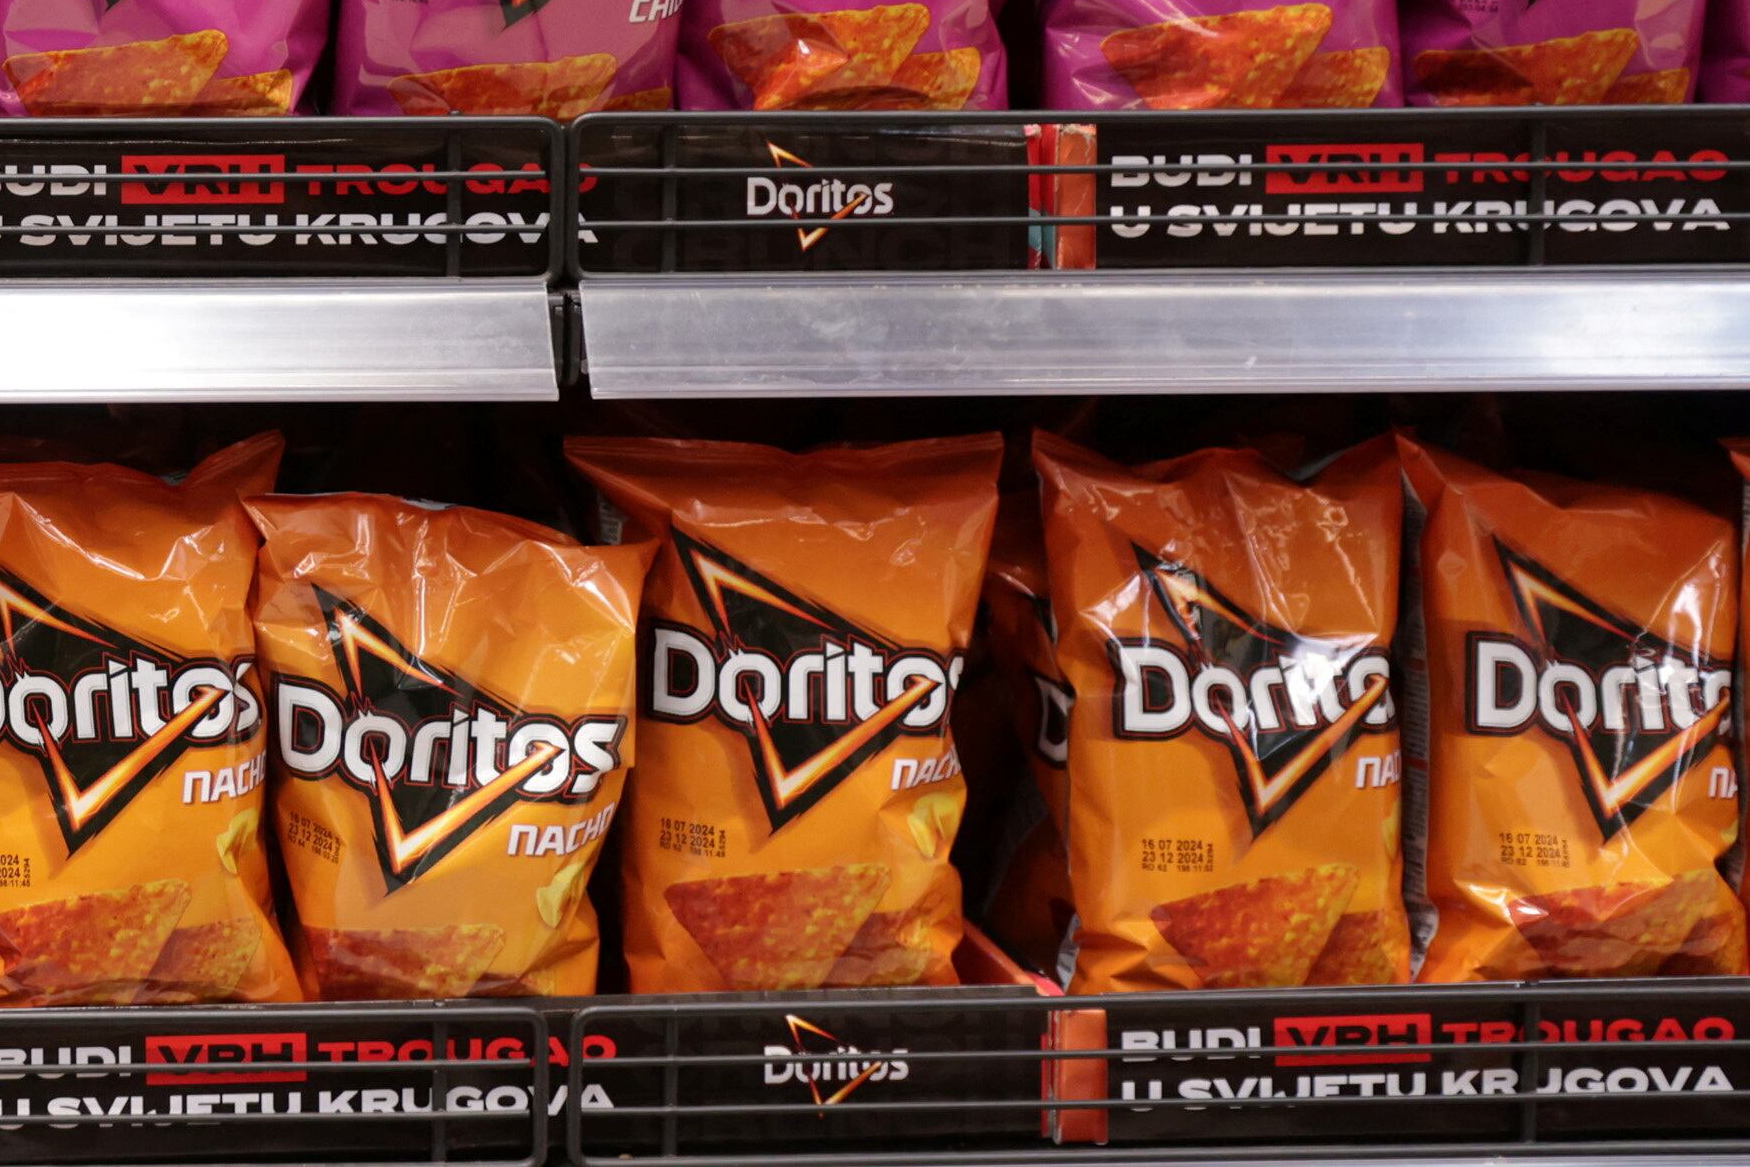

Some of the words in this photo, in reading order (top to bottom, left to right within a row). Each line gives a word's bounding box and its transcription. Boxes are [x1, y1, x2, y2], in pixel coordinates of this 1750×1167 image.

[132, 162, 274, 195] VRH
[1111, 154, 1252, 187] BUDI
[1277, 150, 1413, 185] VRH
[747, 177, 894, 215] Doritos
[19, 214, 280, 246] SVIJETU
[1111, 205, 1151, 238] U
[1166, 202, 1417, 236] SVIJETU
[1433, 198, 1731, 232] KRUGOVA
[1120, 644, 1395, 733] Dorito
[1477, 640, 1731, 733] Dorit
[279, 681, 622, 794] Doritos
[891, 742, 961, 790] NACH
[508, 806, 614, 857] NACHO
[1177, 839, 1203, 850] 2024
[1142, 850, 1155, 862] 23
[1160, 852, 1173, 863] 12
[1177, 852, 1203, 864] 2024
[158, 1043, 295, 1075] VRH
[1121, 1028, 1260, 1062] BUDI
[764, 1045, 909, 1084] Doritos
[47, 1092, 301, 1128] SVIJETU
[1122, 1081, 1153, 1113] U
[1177, 1073, 1427, 1111] SVIJETU
